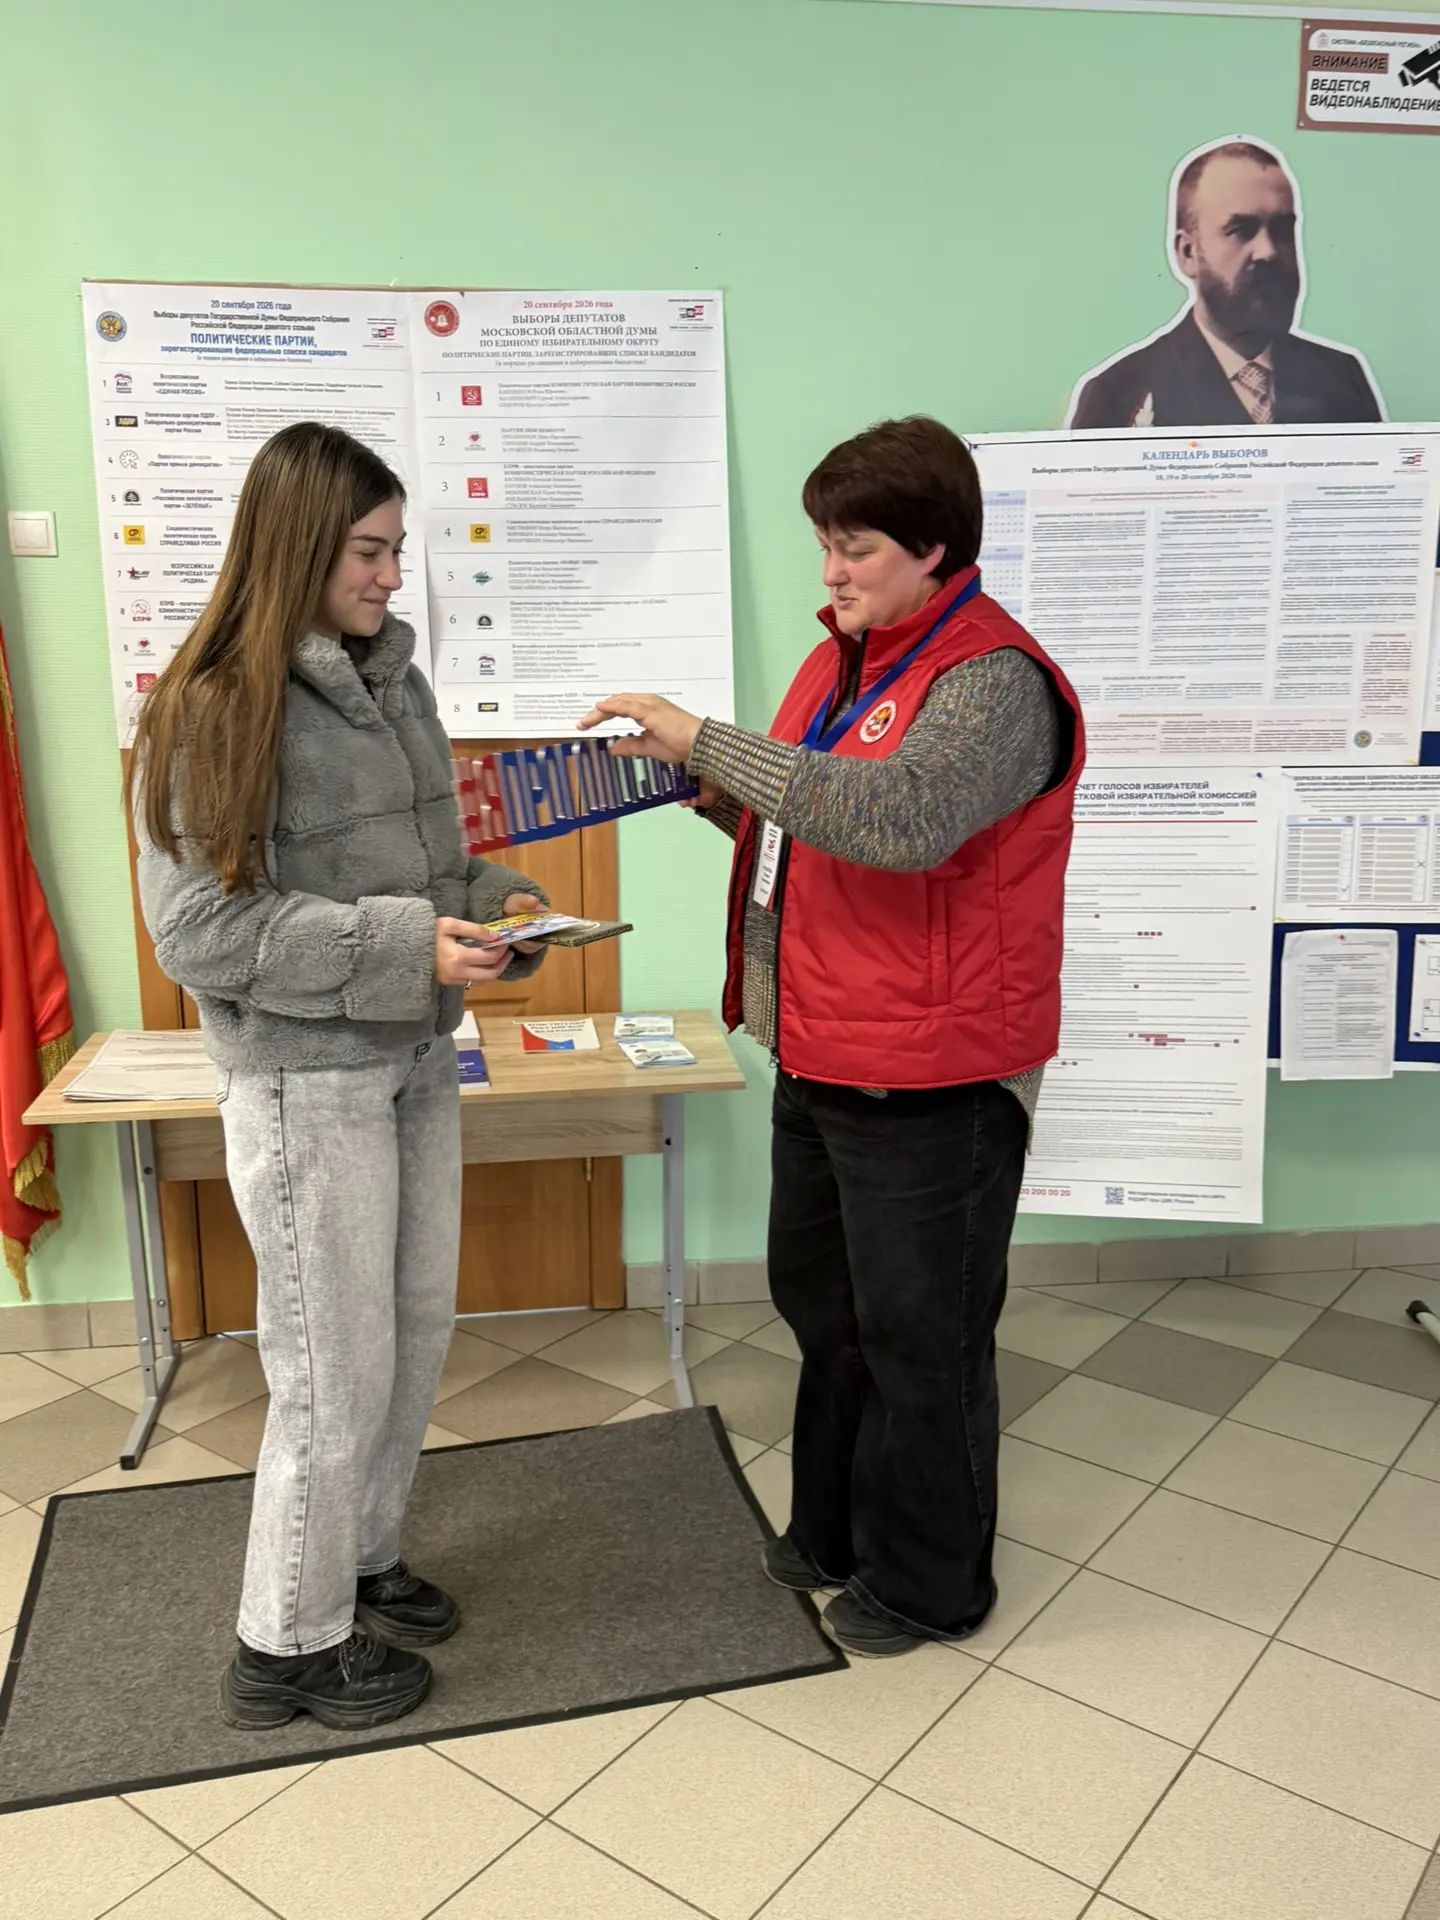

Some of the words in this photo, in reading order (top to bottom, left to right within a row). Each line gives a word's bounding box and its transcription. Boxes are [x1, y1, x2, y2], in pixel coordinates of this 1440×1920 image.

[1312, 55, 1387, 69] ВНИМАНИЕ
[1310, 79, 1370, 93] ВЕДЕТСЯ
[1309, 94, 1440, 112] ВИДЕОНАБЛЮДЕНИЕ
[211, 300, 220, 308] 20
[221, 301, 255, 310] сентября
[256, 301, 273, 310] 2026
[523, 300, 532, 309] 20
[534, 300, 573, 310] сентября
[574, 299, 593, 308] 2026
[512, 314, 560, 324] ВЫБОРЫ
[562, 313, 626, 324] ДЕПУТАТОВ
[480, 326, 556, 337] МОСКОВСКОЙ
[558, 325, 623, 336] ОБЛАСТНОЙ
[626, 326, 658, 337] ДУМЫ
[190, 332, 272, 345] ПОЛИТИЧЕСКИЕ
[274, 335, 317, 348] ПАРТИИ,
[479, 339, 493, 348] ПО
[495, 338, 539, 348] ЕДИНОМУ
[626, 338, 660, 347] ОКРУГУ
[437, 391, 441, 401] 1
[438, 435, 446, 446] 2
[1143, 450, 1210, 461] КАЛЕНДАРЬ
[1212, 448, 1269, 459] ВЫБОРОВ
[442, 481, 448, 492] 3
[444, 527, 451, 537] 4
[448, 571, 454, 581] 5
[450, 614, 457, 624] 6
[452, 657, 459, 667] 7
[454, 704, 460, 712] 8
[1075, 783, 1097, 791] СЧЕТ
[1098, 782, 1141, 791] ГОЛОСОВ
[1143, 781, 1209, 790] ИЗБИРАТЕЛЕЙ
[1073, 791, 1115, 800] СТКОВОЙ
[1117, 791, 1196, 800] ИЗБИРАТЕЛЬНОЙ
[1199, 790, 1257, 799] КОМИССИЕЙ
